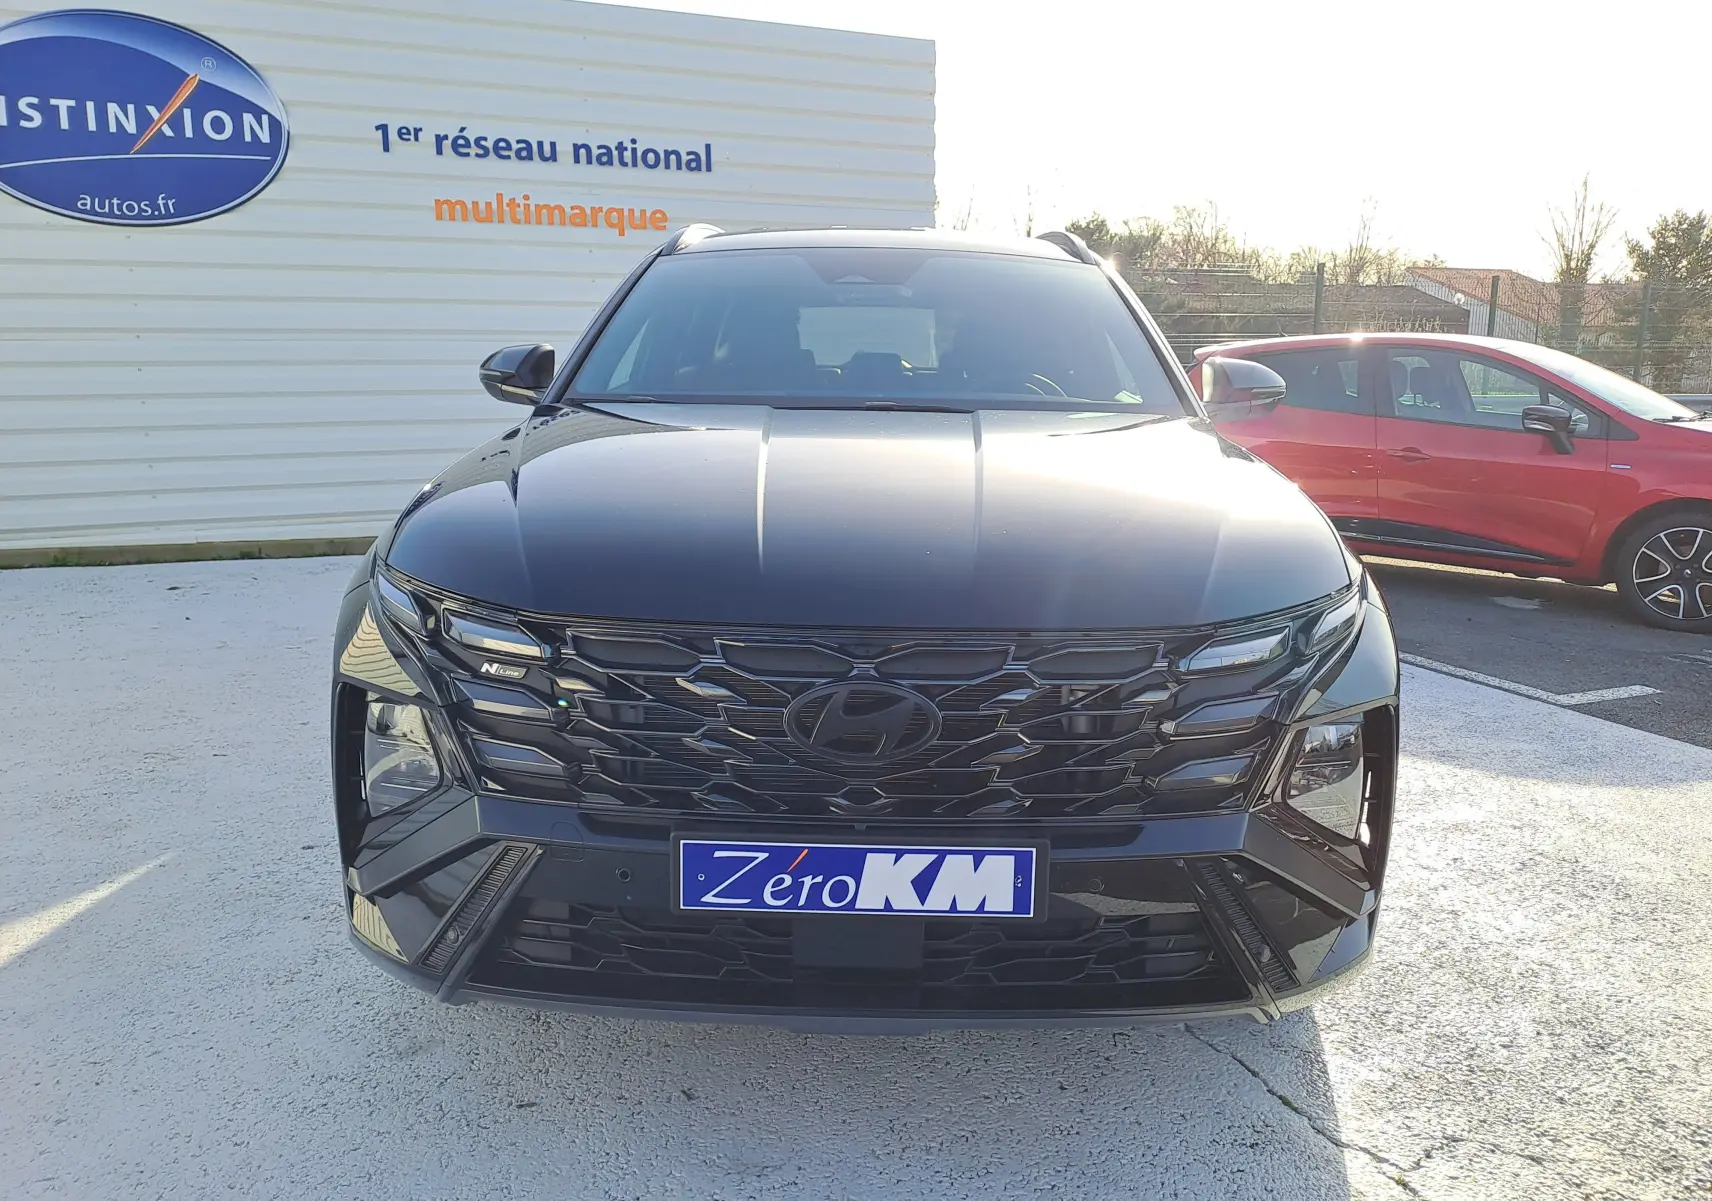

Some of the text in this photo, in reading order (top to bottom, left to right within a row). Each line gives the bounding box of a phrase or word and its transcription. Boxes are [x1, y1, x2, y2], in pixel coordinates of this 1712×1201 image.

[374, 123, 713, 173] 1er réseau national
[76, 193, 176, 216] autos.fr
[433, 192, 669, 237] multimarque
[500, 668, 519, 676] Line
